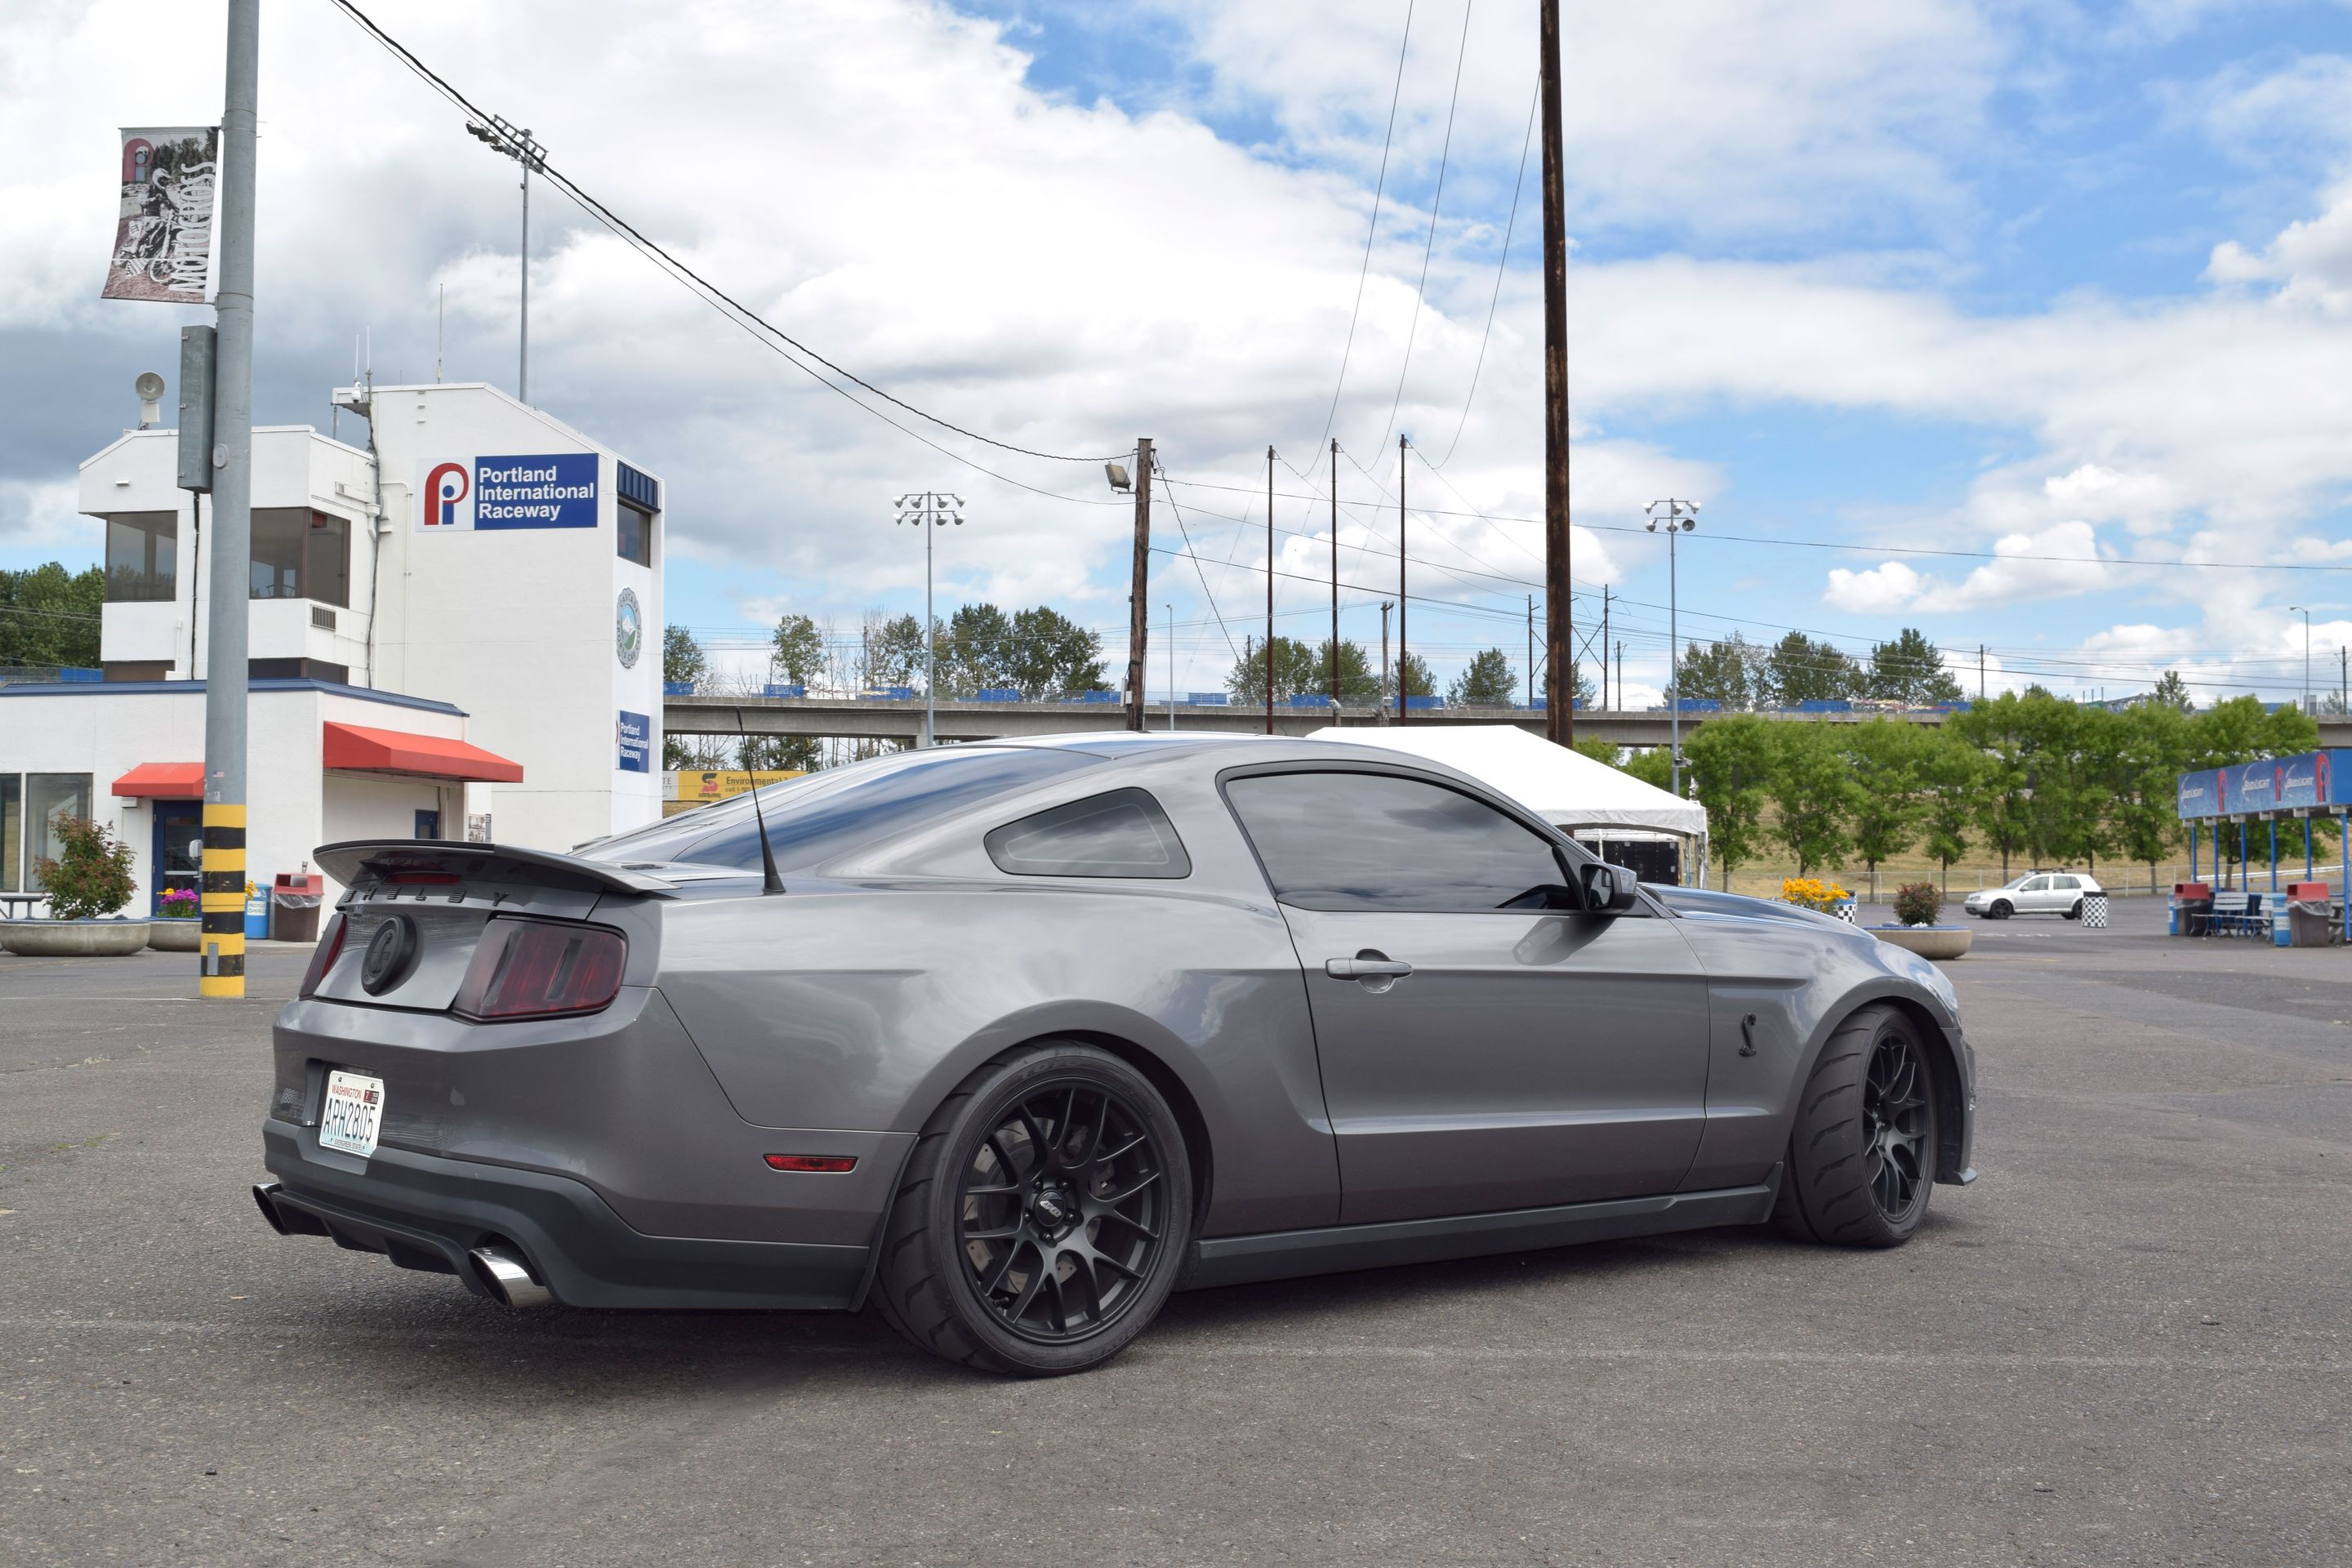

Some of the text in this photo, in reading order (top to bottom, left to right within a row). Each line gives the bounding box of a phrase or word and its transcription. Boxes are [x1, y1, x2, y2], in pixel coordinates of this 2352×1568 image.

[168, 162, 216, 292] MOTOCROSS
[479, 466, 557, 483] Portland
[479, 483, 595, 501] International
[479, 503, 561, 521] Raceway
[621, 722, 640, 735] Portland
[621, 737, 648, 749] International
[621, 746, 641, 762] Raceway
[343, 886, 510, 907] SHELBY
[332, 1084, 362, 1099] WASHINGTON
[323, 1098, 376, 1143] ARH2805
